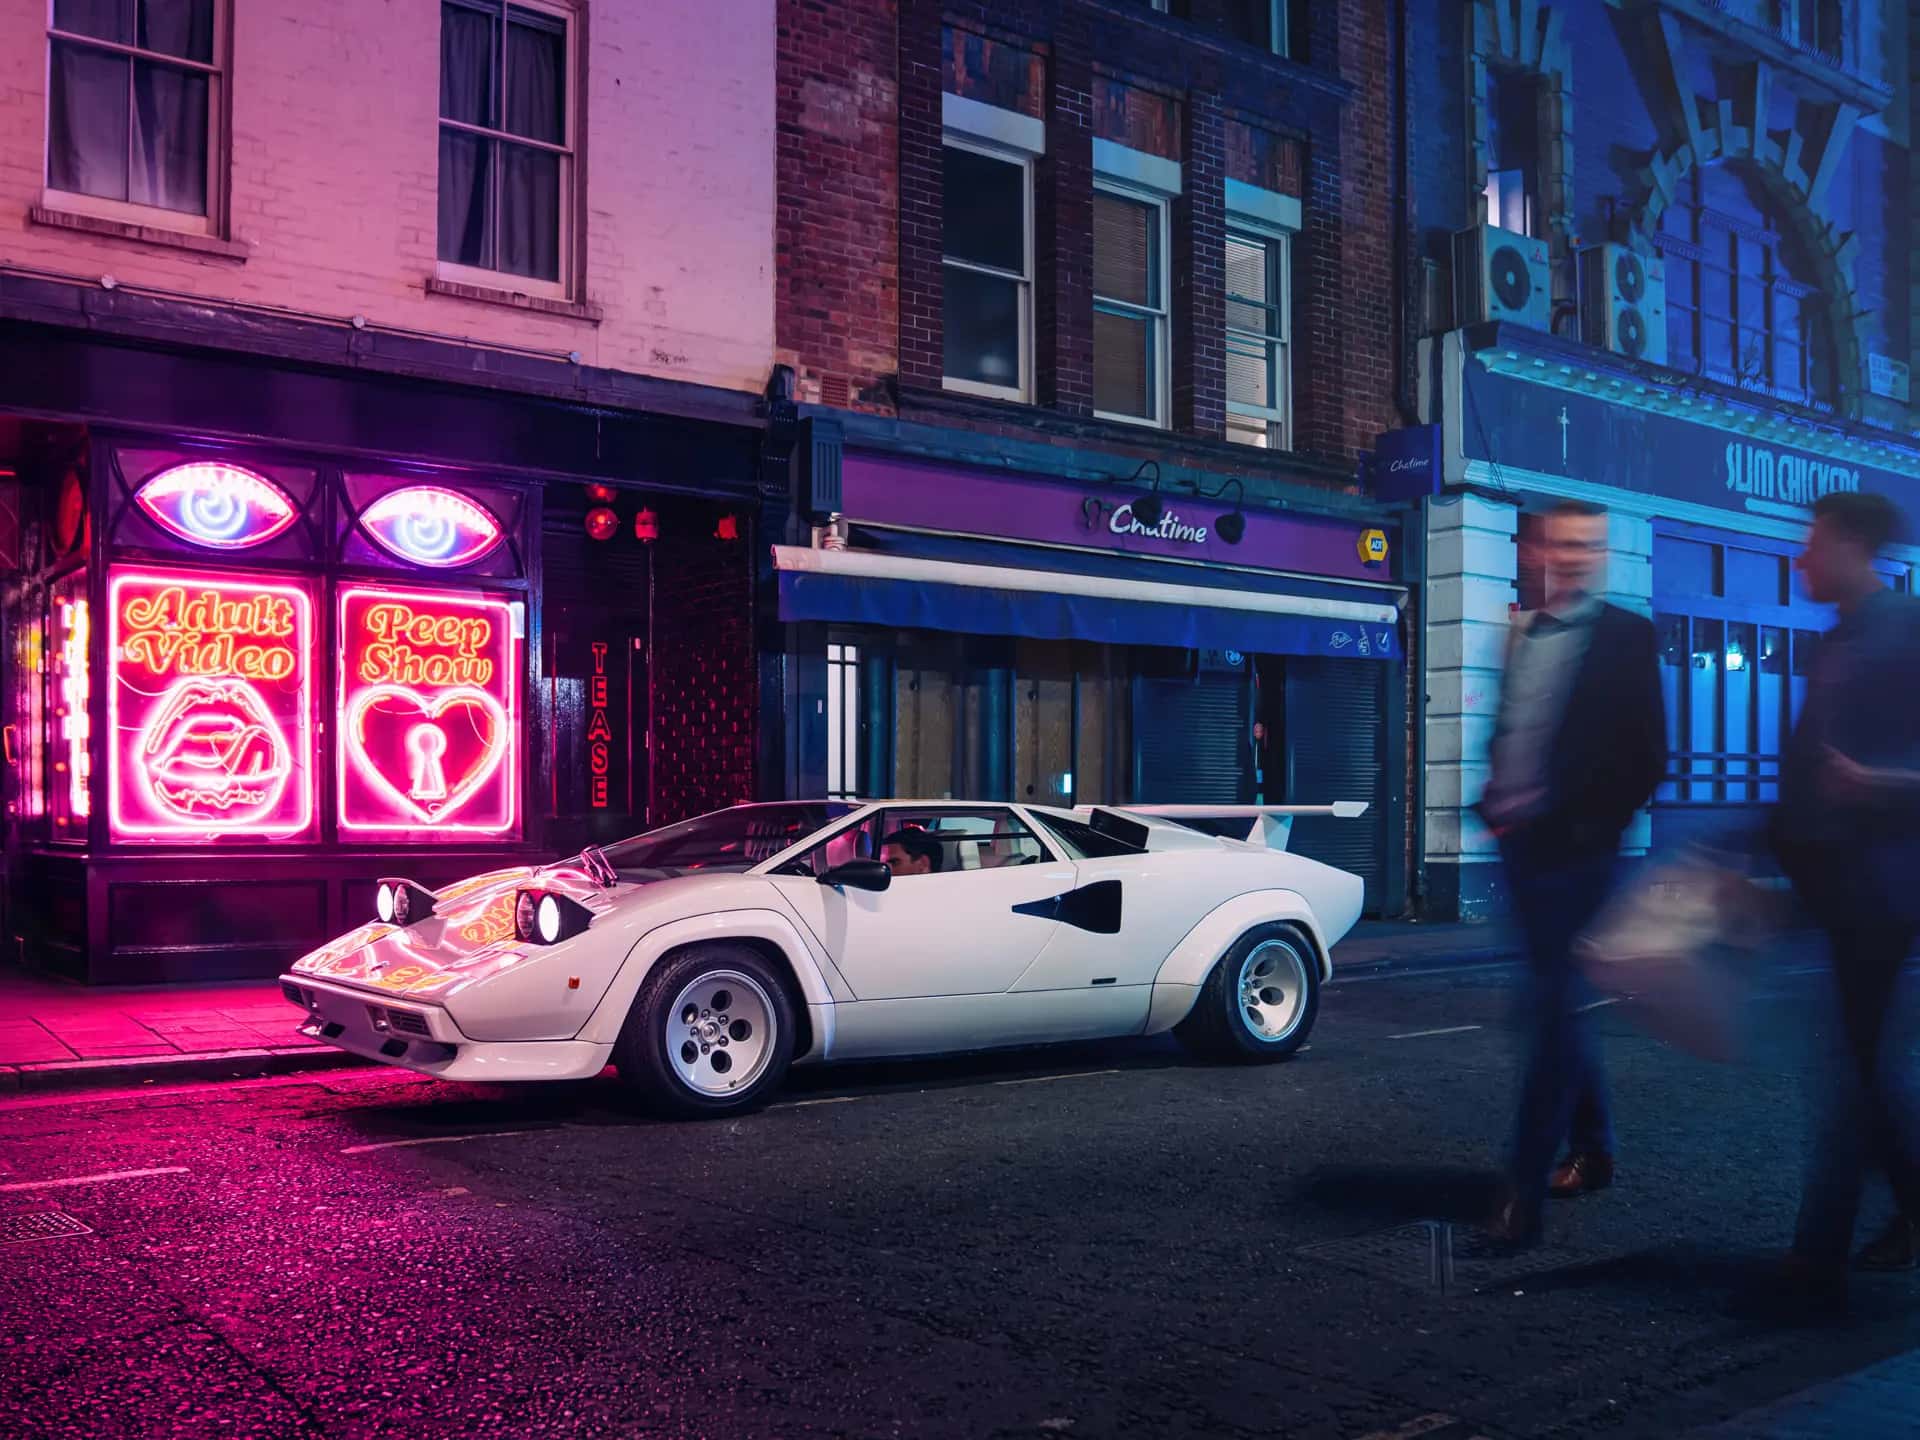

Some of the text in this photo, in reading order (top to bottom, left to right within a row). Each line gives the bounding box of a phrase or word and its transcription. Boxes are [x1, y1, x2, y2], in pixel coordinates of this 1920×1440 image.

[1390, 457, 1429, 472] Chatime
[1725, 441, 1774, 498] SLIM
[126, 587, 294, 636] Adult
[367, 603, 491, 657] Peep
[126, 631, 294, 679] Video
[362, 644, 492, 686] Show
[588, 642, 611, 807] TEASE
